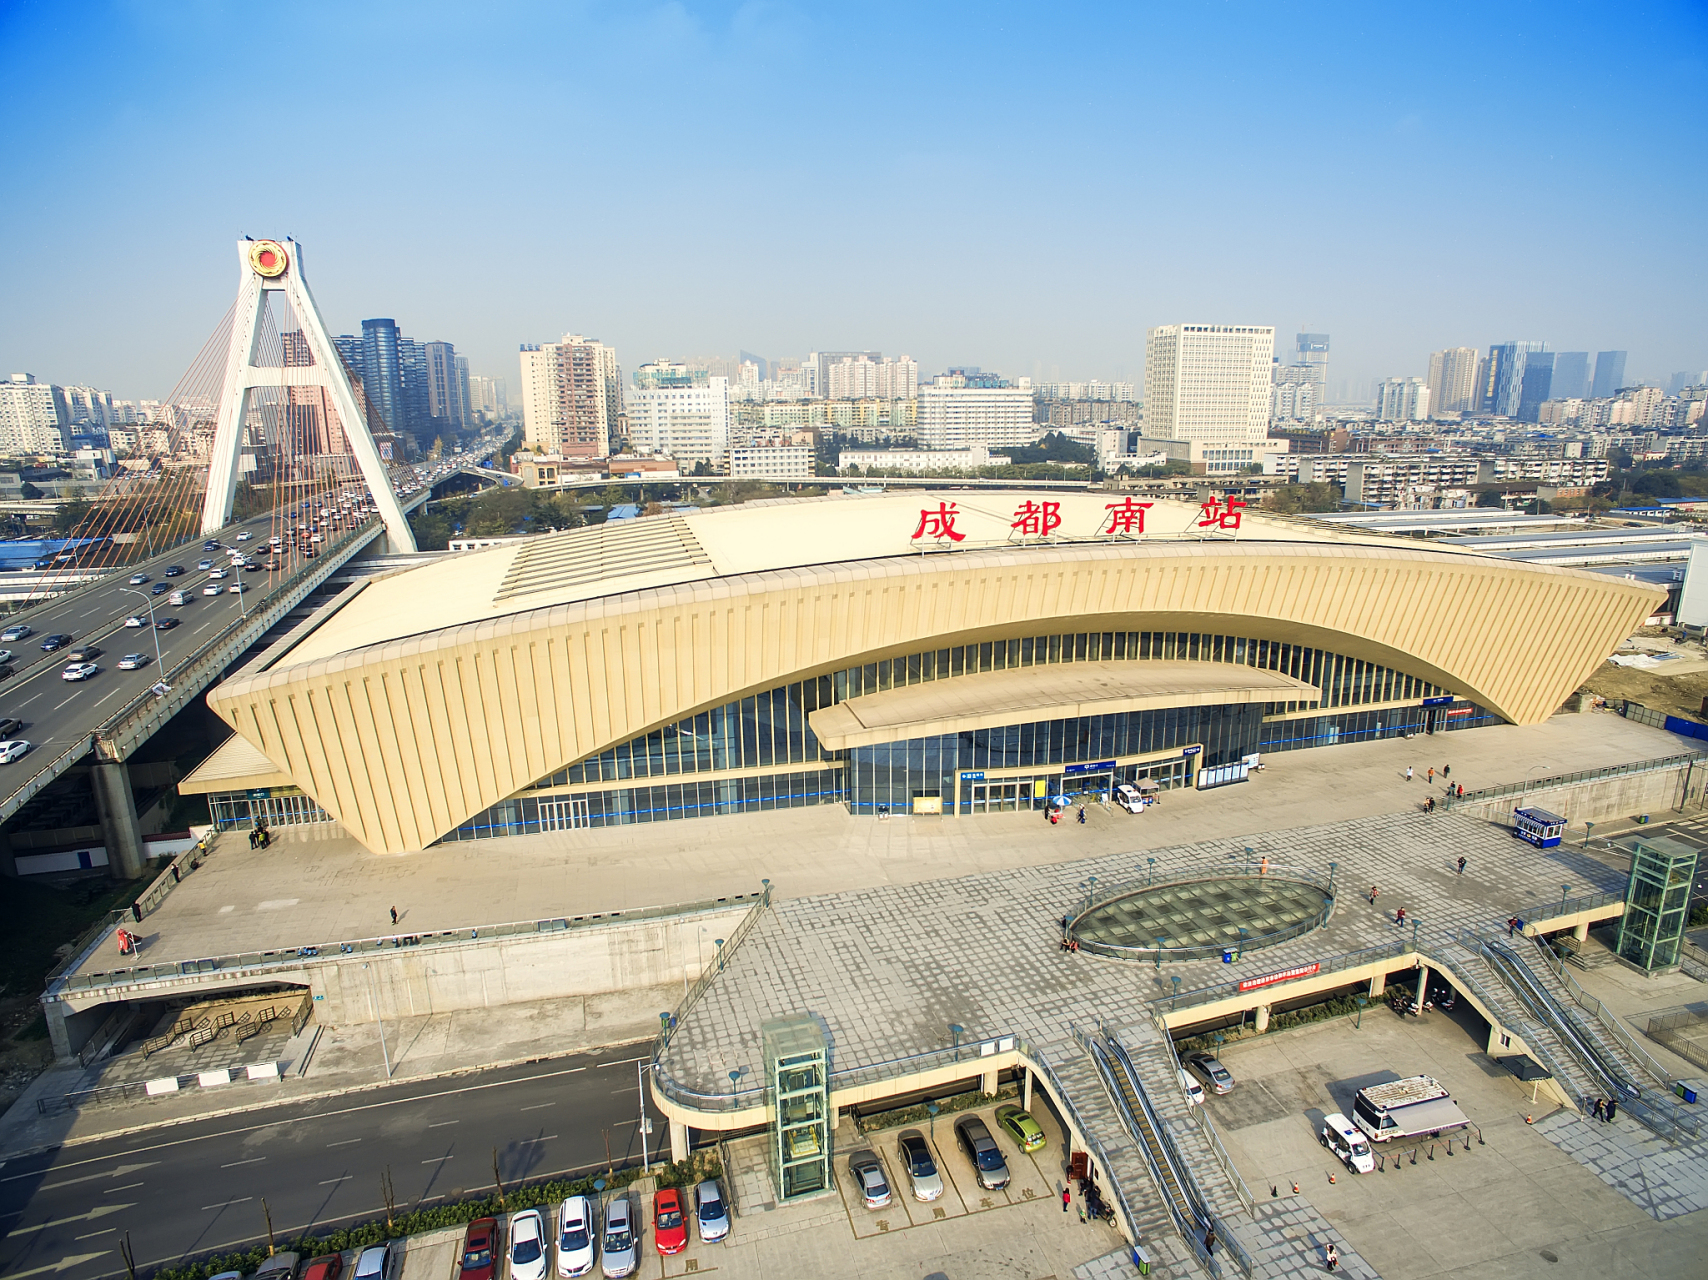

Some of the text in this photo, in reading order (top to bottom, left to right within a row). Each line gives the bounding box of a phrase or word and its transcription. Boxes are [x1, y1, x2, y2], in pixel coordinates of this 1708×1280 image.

[911, 495, 1247, 542] 成都南站
[876, 1187, 1038, 1232] 专用车位
[685, 1258, 698, 1272] 用
